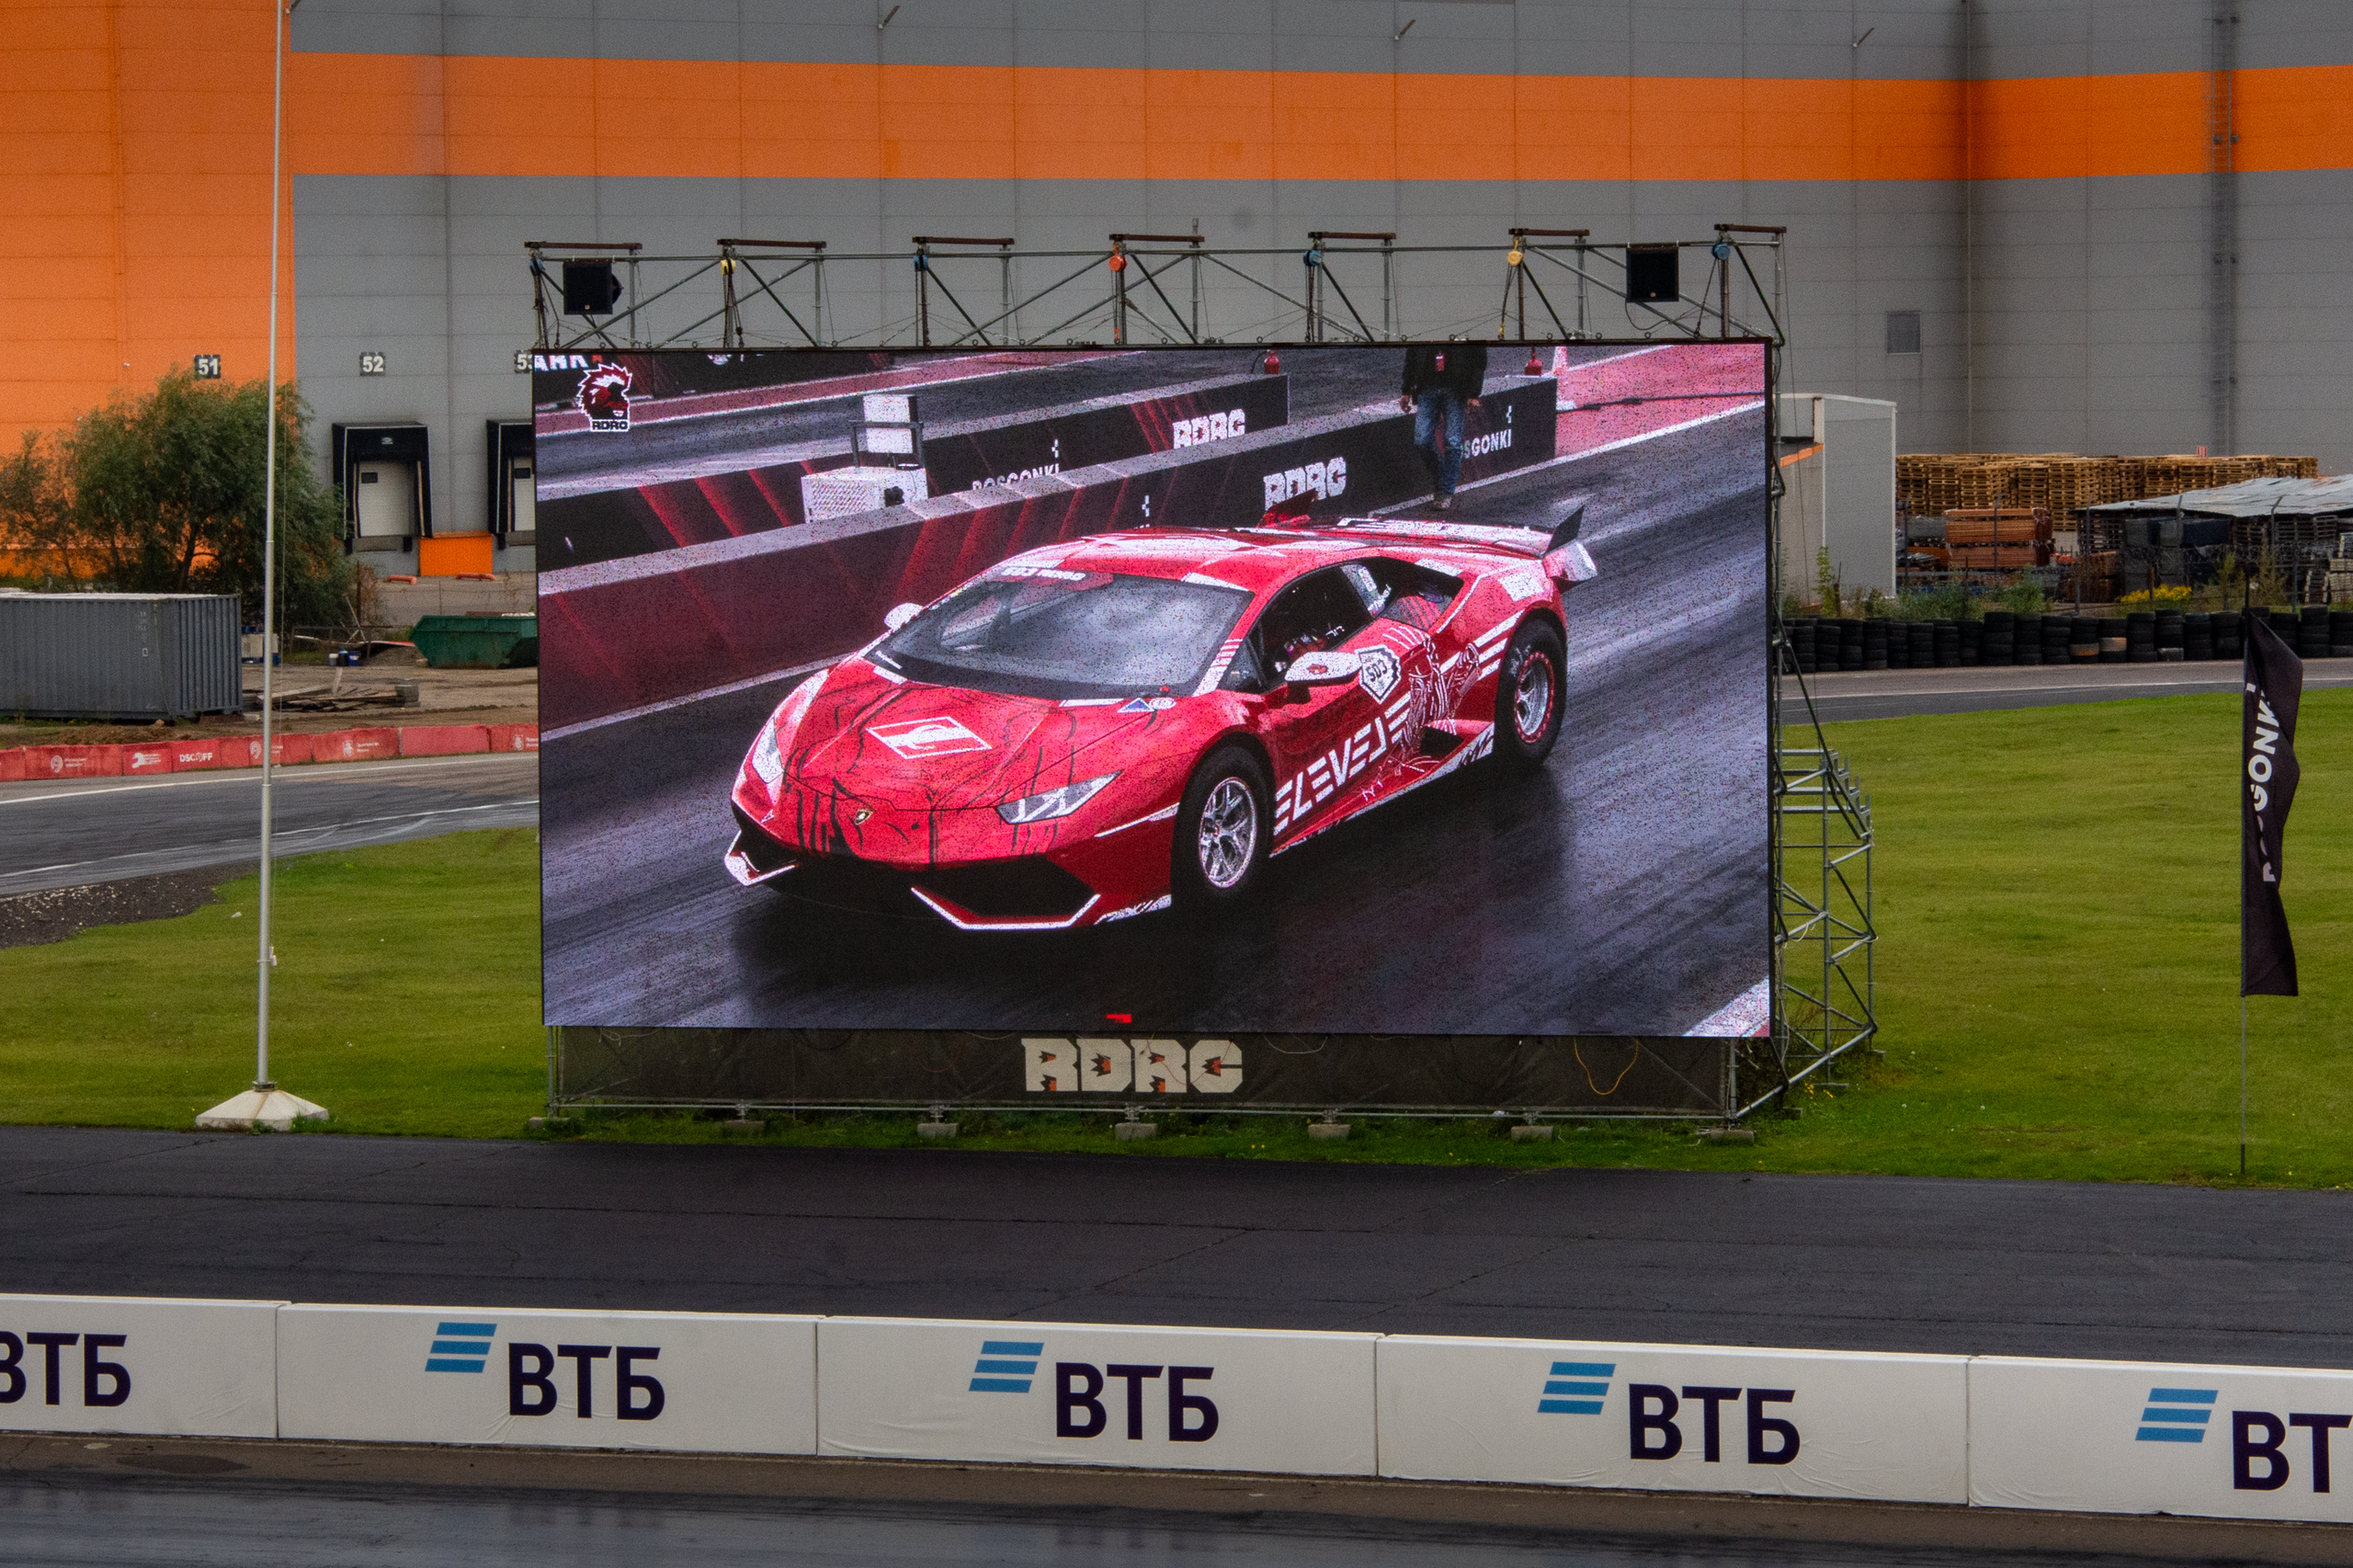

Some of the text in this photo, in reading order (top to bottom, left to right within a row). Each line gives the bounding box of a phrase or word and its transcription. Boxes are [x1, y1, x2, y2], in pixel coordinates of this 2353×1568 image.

[199, 358, 218, 375] 51
[363, 356, 384, 372] 52
[1173, 409, 1245, 449] RDRC
[1461, 428, 1512, 460] SGONKI
[1021, 1039, 1243, 1093] RDRC
[508, 1343, 665, 1421] ВТБ
[1056, 1362, 1219, 1443] ВТБ
[1629, 1383, 1801, 1465] ВТБ
